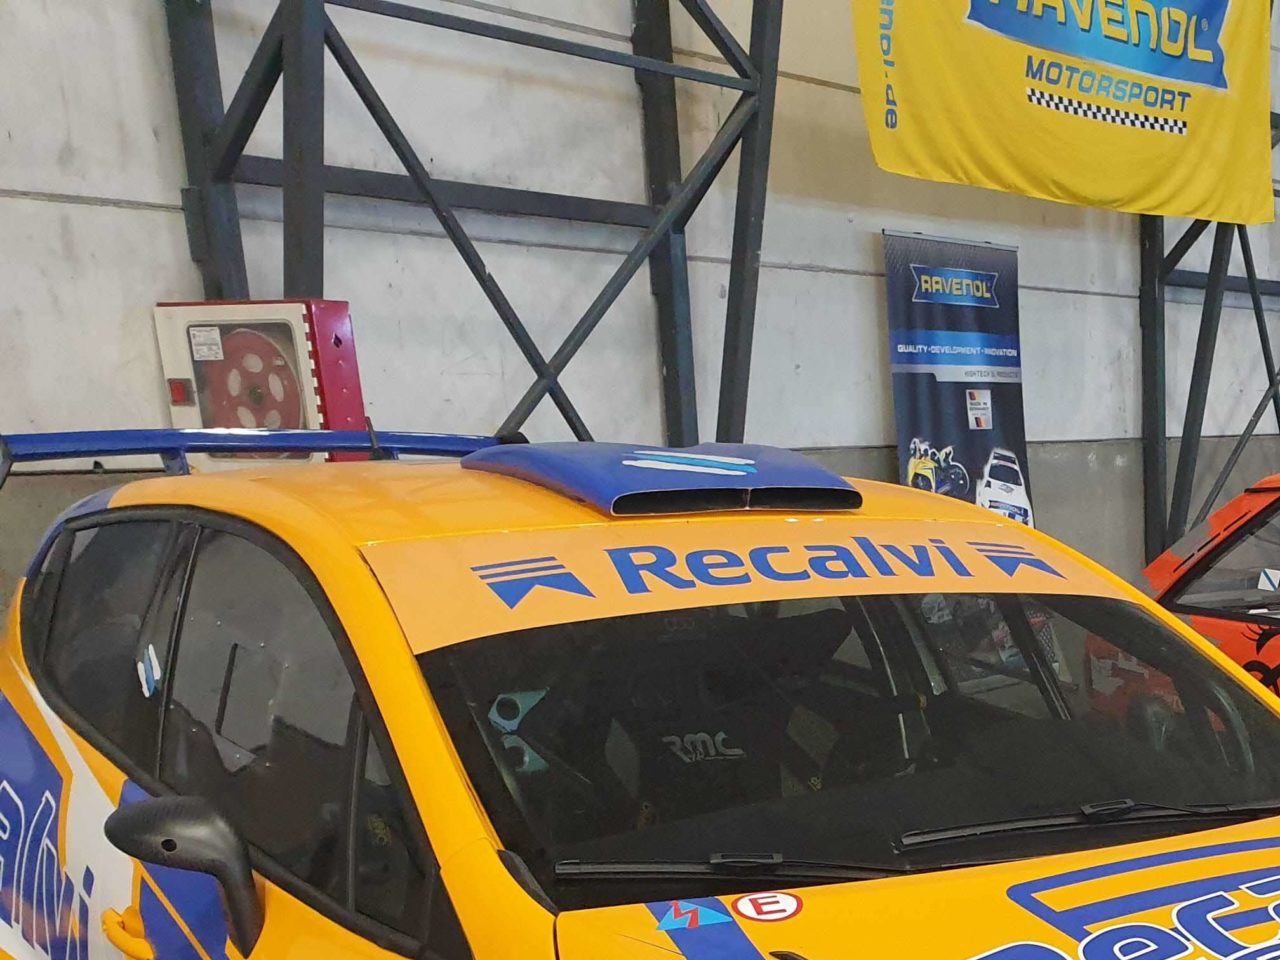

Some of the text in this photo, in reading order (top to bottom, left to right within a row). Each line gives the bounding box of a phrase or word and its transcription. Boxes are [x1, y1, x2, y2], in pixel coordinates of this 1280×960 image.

[1025, 55, 1192, 112] MOTORSPORT
[920, 274, 992, 298] RAVENOL
[897, 344, 928, 353] QUALITY
[604, 536, 974, 595] Recalvi
[748, 894, 788, 916] E
